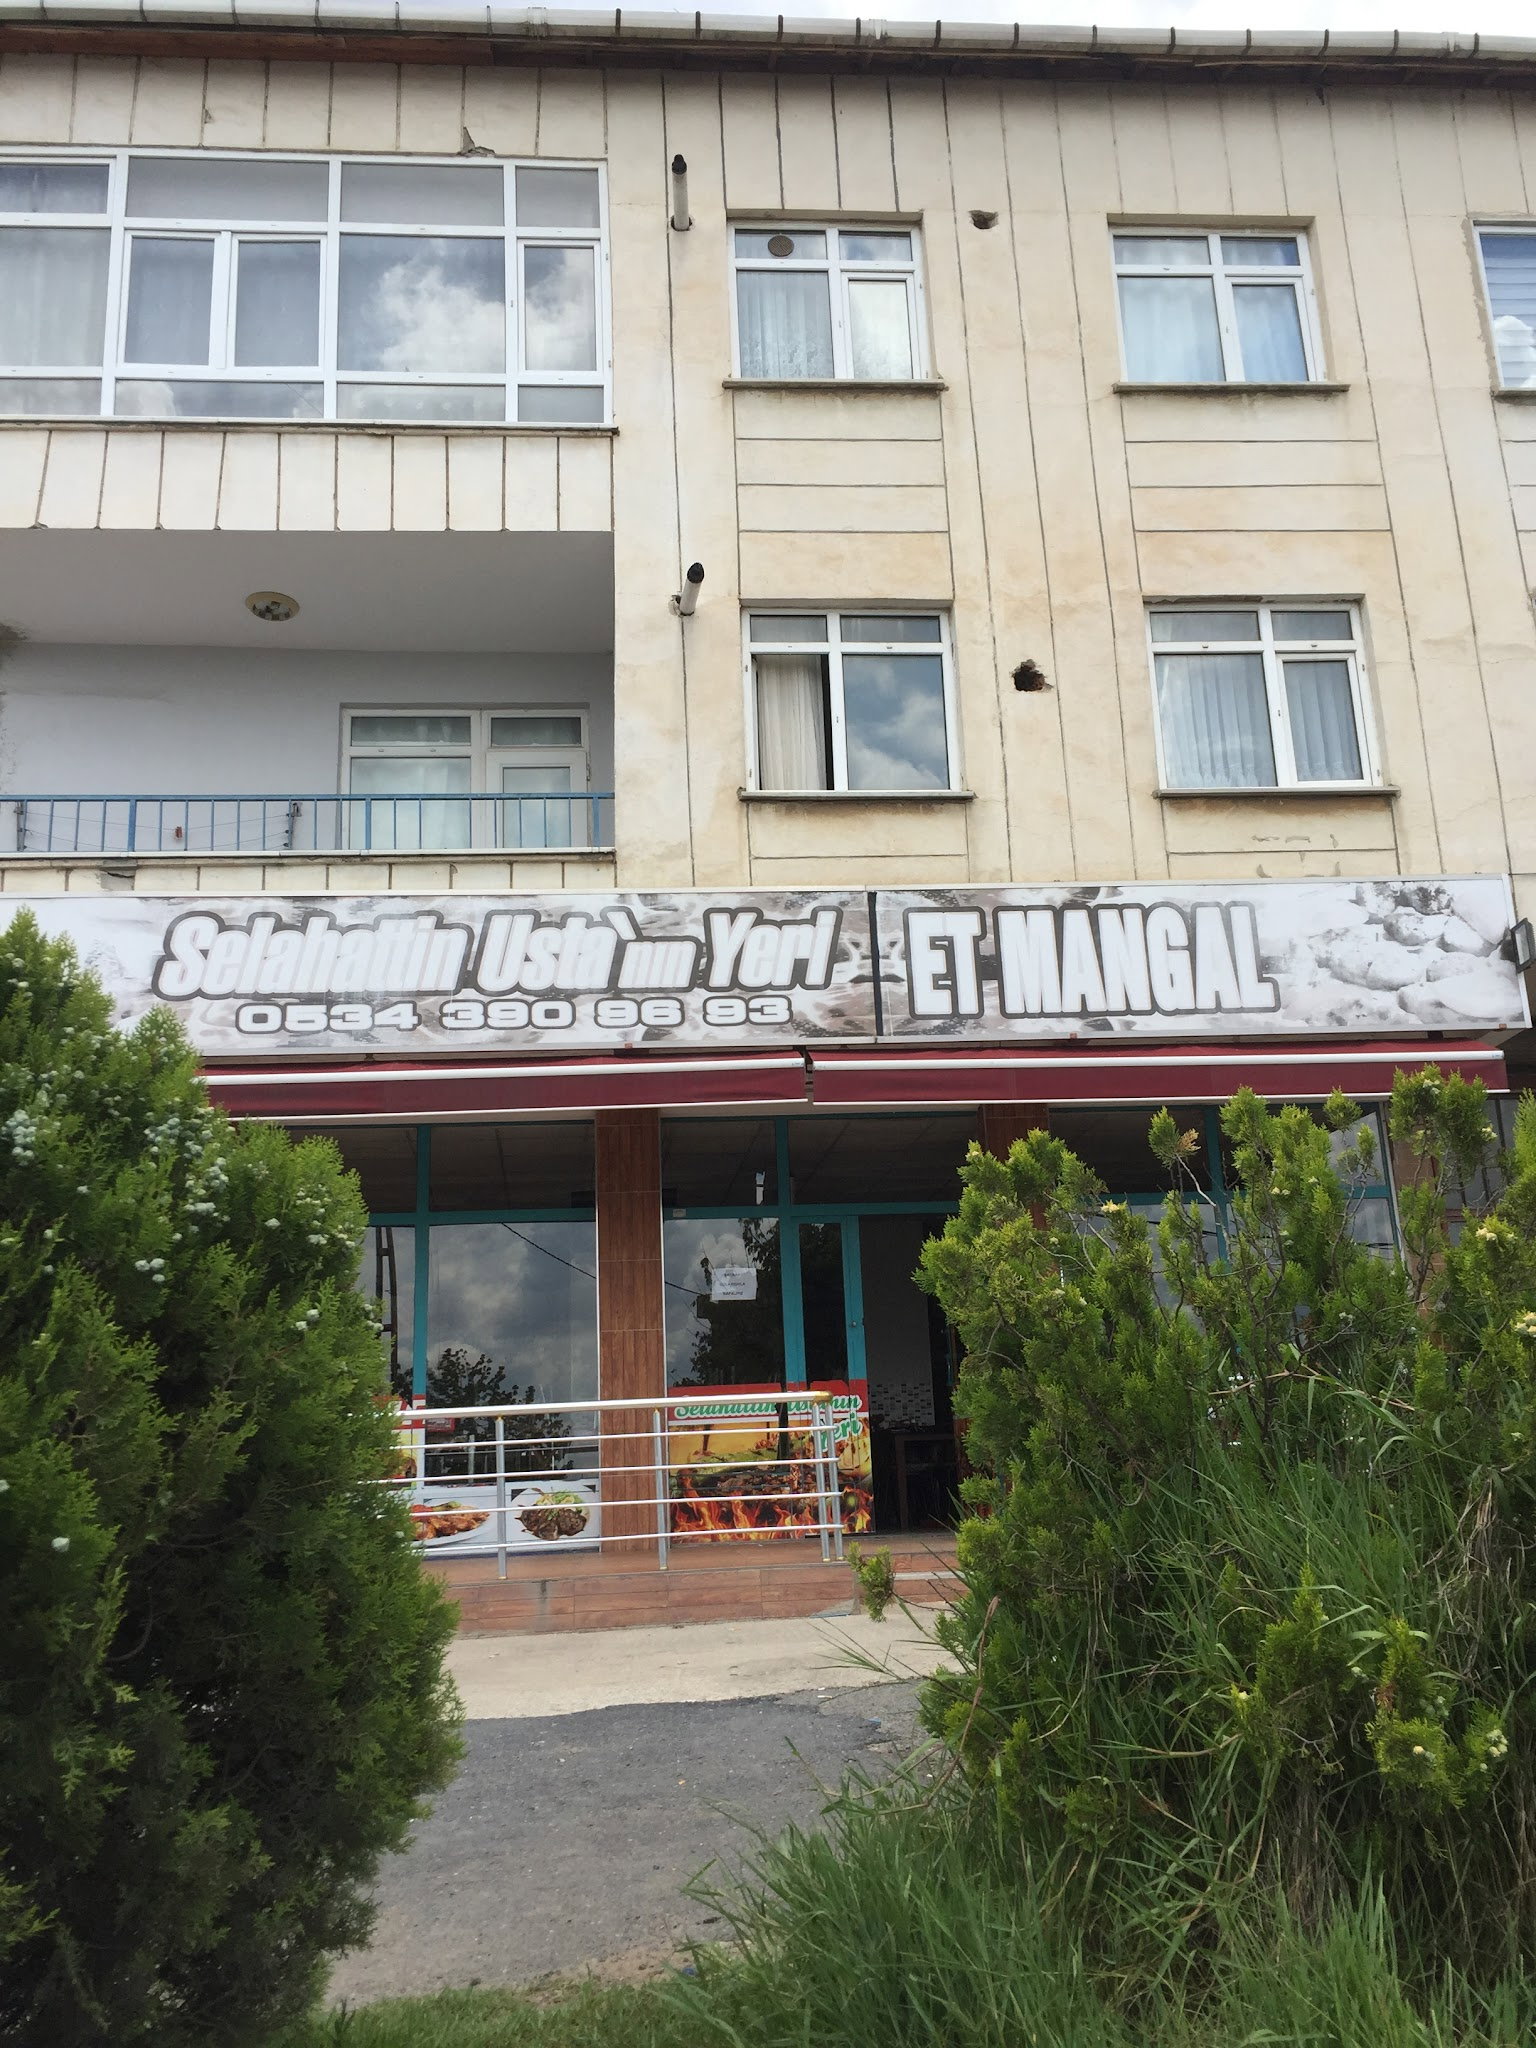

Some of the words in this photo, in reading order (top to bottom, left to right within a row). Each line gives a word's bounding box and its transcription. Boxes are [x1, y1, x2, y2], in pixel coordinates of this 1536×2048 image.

[155, 912, 472, 998] Selahattin
[705, 908, 841, 990] Yeri
[906, 908, 984, 1017] ET
[995, 903, 1278, 1015] MANGAL
[238, 1001, 421, 1034] 0534
[440, 1000, 575, 1030] 390
[595, 997, 684, 1027] 96
[703, 996, 793, 1025] 93
